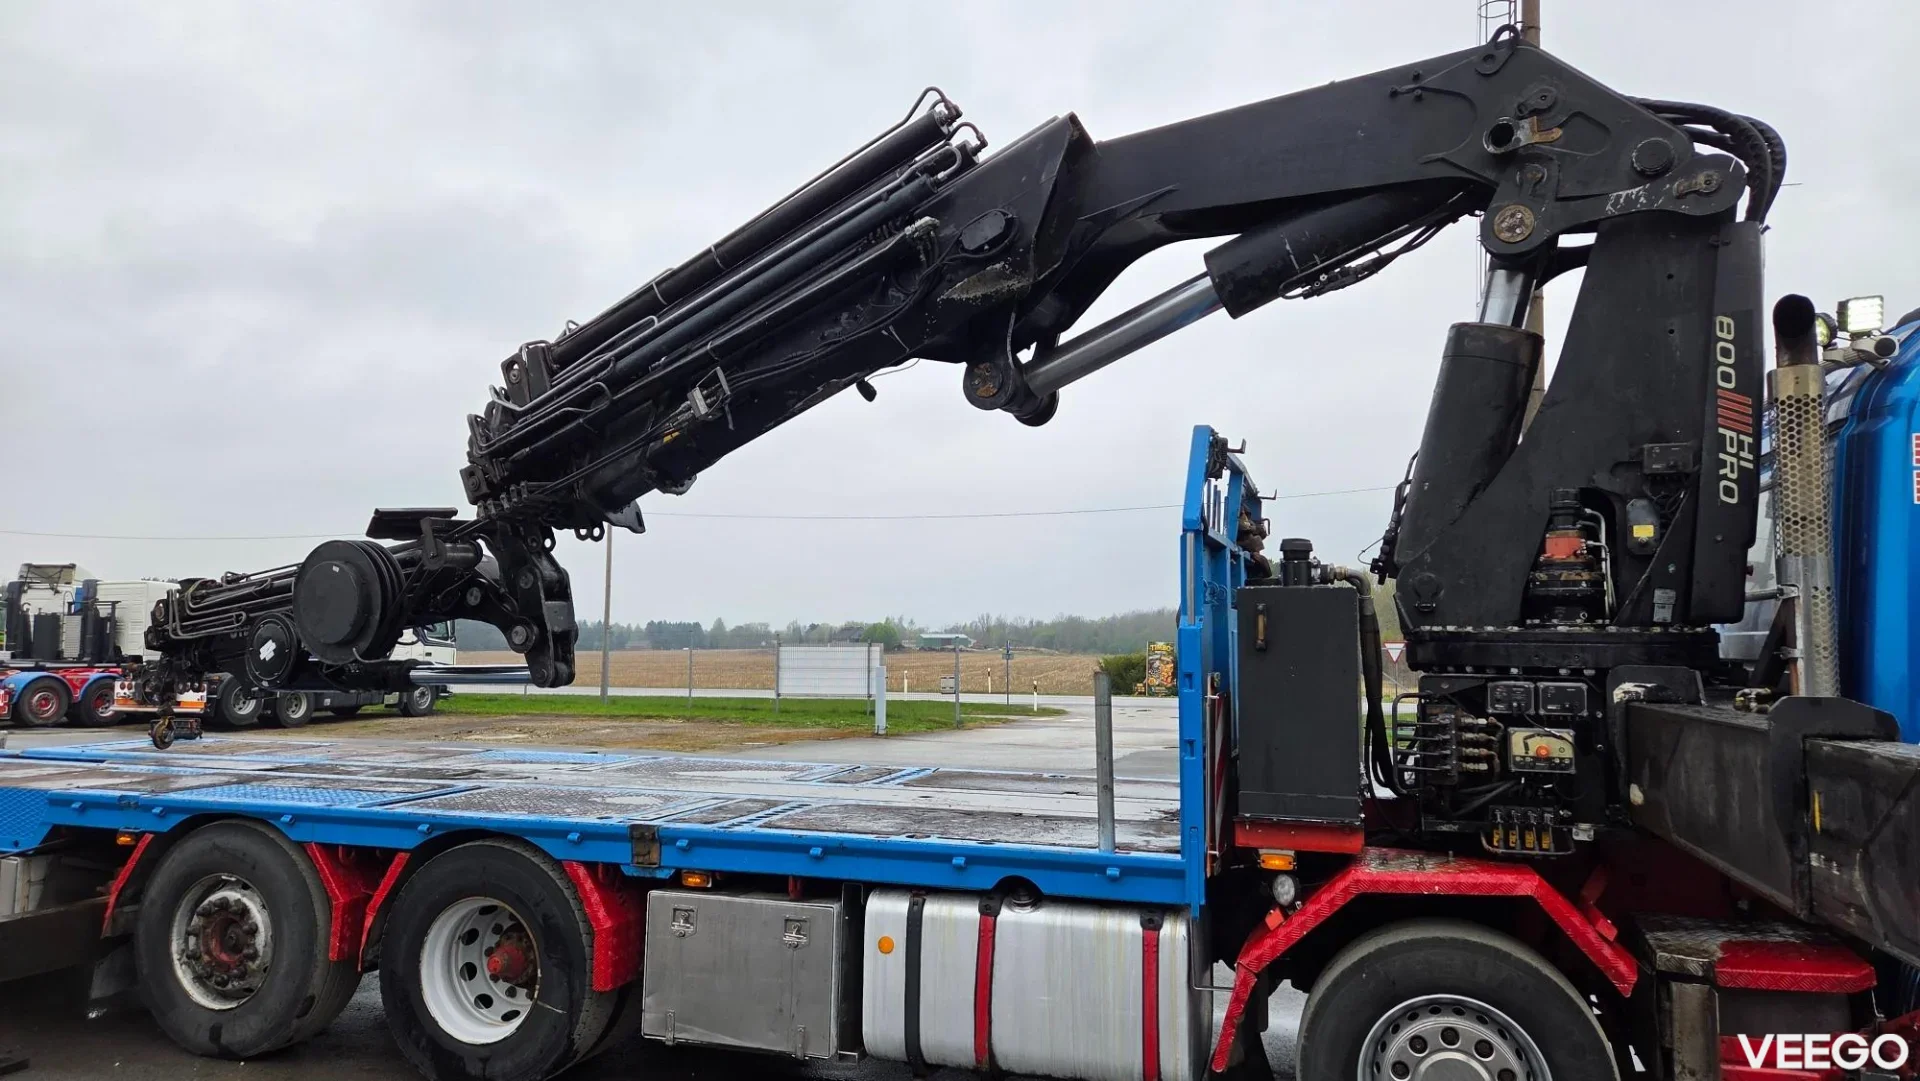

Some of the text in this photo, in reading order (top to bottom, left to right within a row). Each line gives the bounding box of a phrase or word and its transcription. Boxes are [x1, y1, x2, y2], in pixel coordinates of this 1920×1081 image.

[1716, 315, 1736, 389] 800
[1718, 427, 1738, 504] PRO
[1739, 433, 1754, 469] HI
